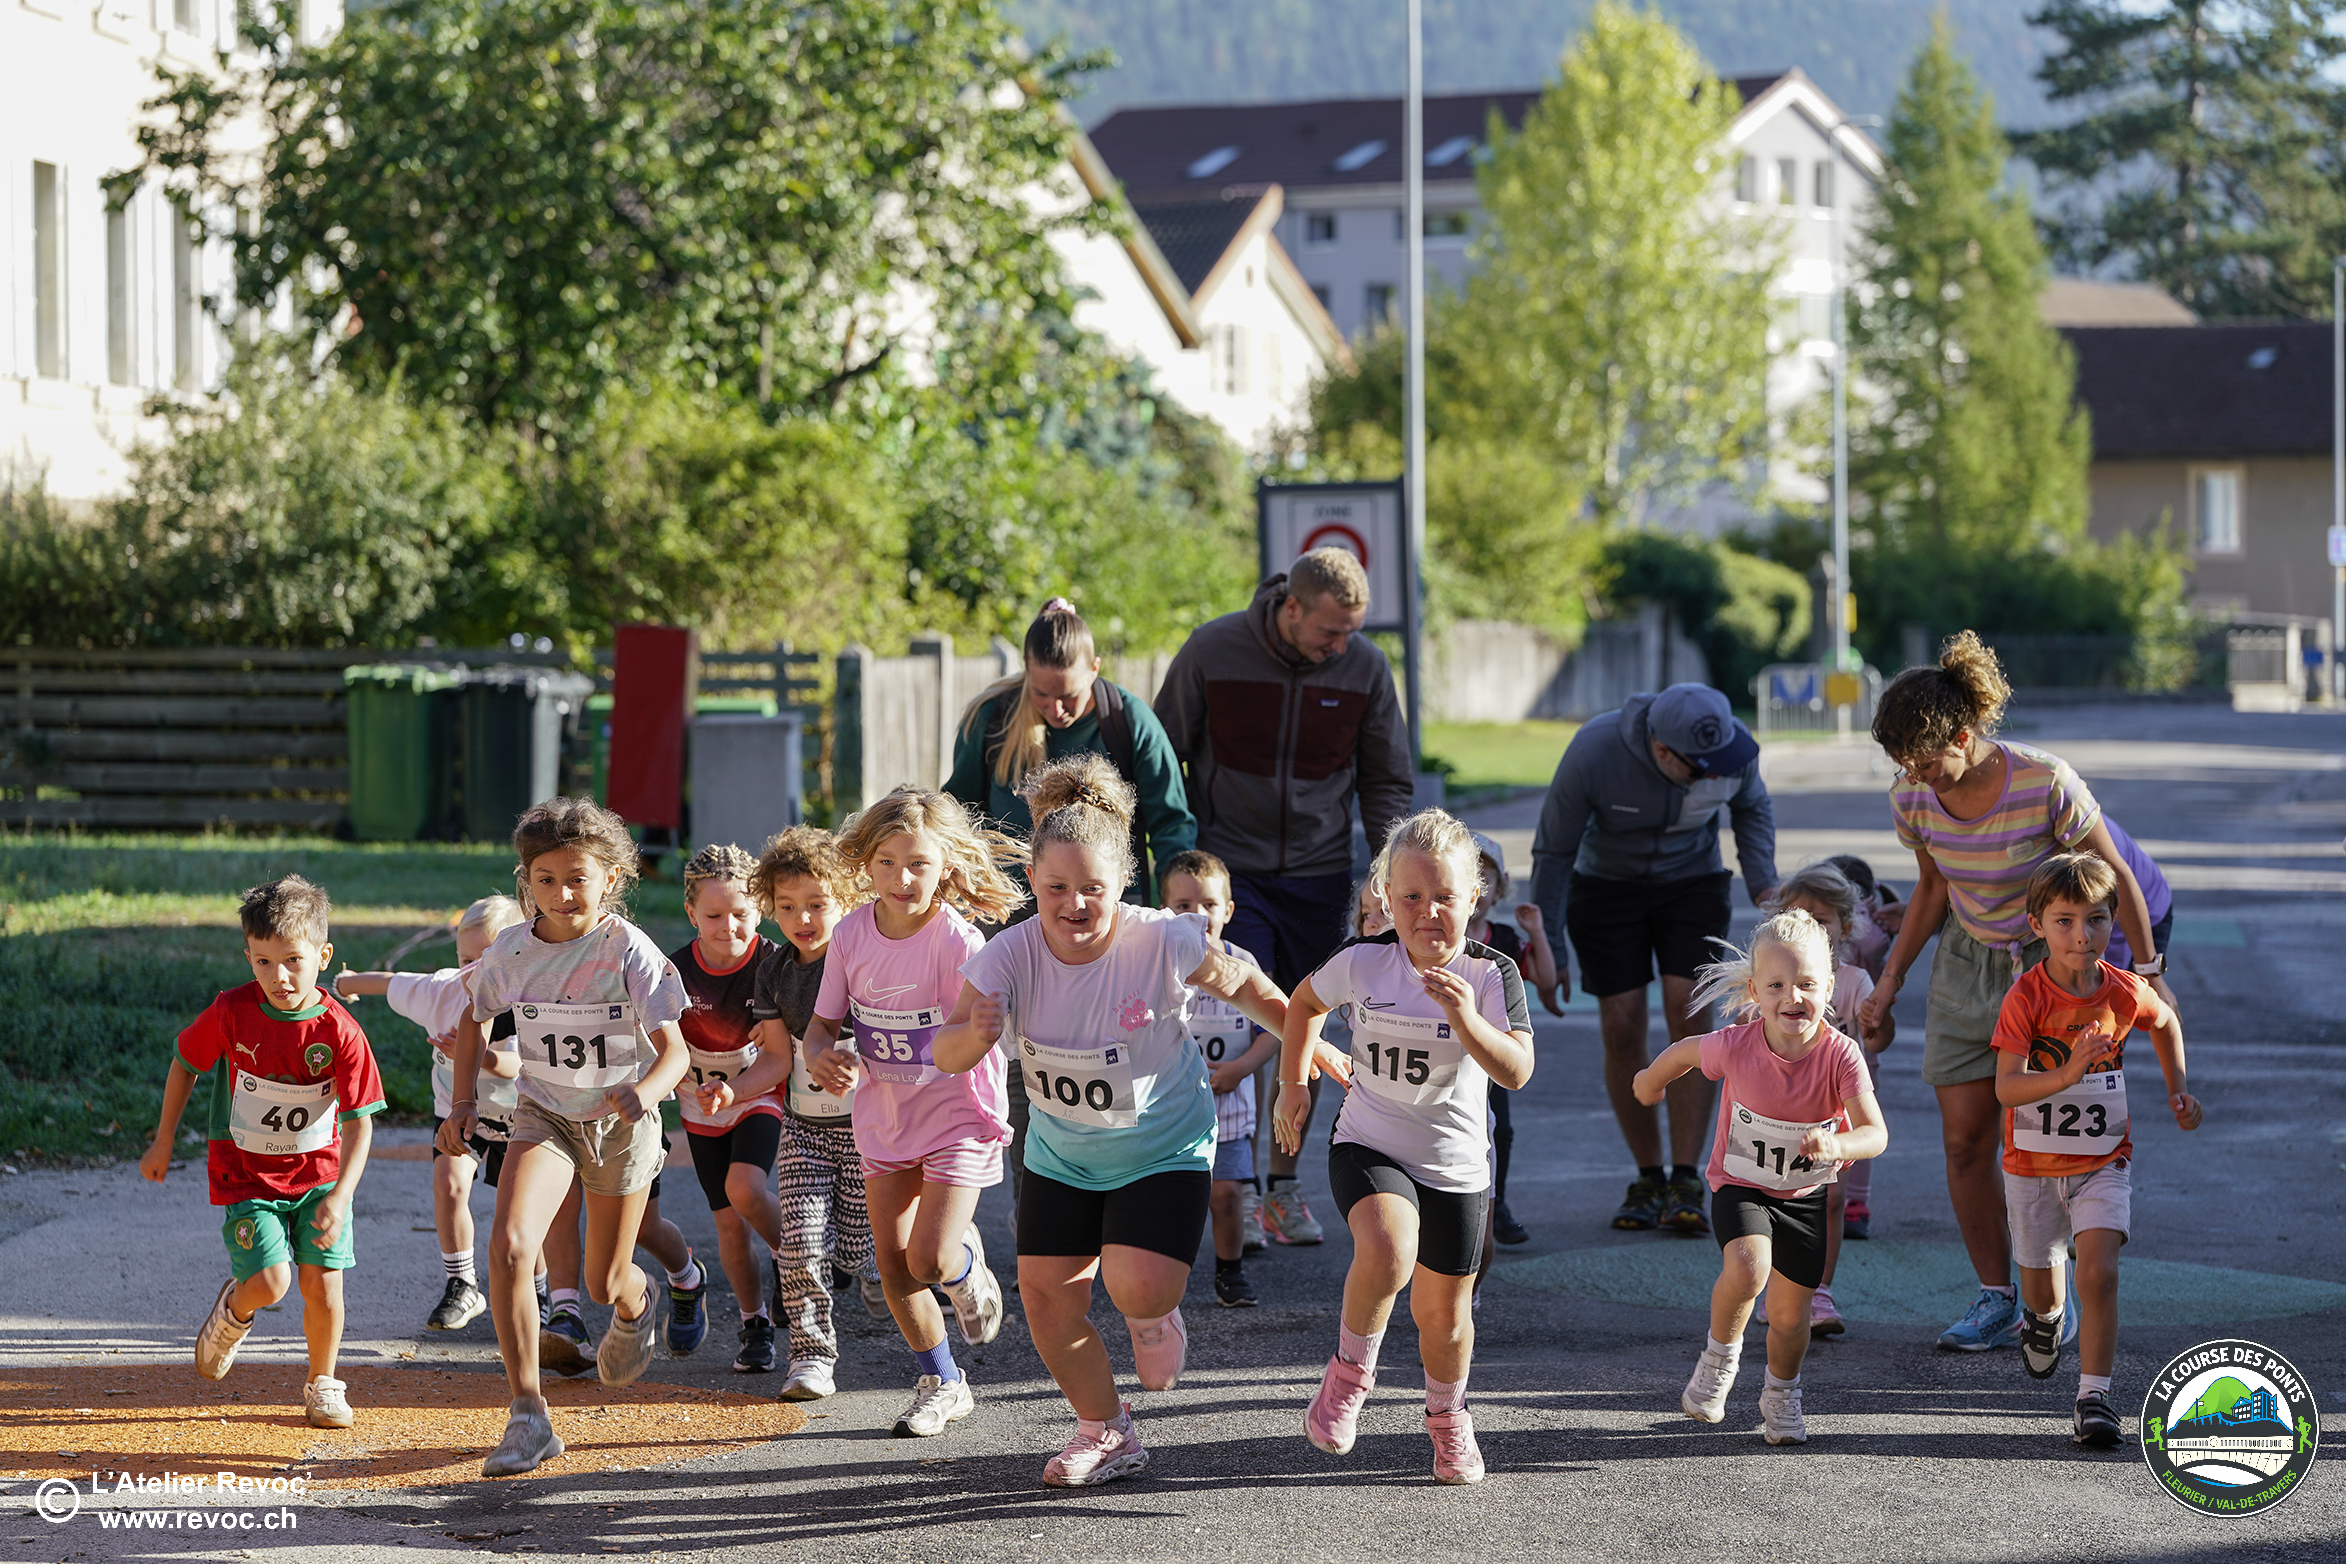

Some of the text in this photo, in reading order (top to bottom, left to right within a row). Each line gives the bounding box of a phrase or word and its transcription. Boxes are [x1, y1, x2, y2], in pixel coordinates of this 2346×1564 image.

[1376, 1016, 1397, 1025] COURSE
[540, 1033, 607, 1070] 131
[871, 1031, 913, 1062] 35
[1045, 1050, 1066, 1058] COURSE
[1367, 1042, 1430, 1085] 115
[876, 1069, 899, 1081] Lena
[267, 1085, 288, 1093] COURSE
[1034, 1070, 1113, 1112] 100
[820, 1103, 840, 1113] Ella
[261, 1105, 309, 1132] 40
[1761, 1120, 1783, 1130] COURSE
[2036, 1102, 2107, 1138] 123
[265, 1142, 298, 1153] Rayan
[1752, 1140, 1813, 1175] 114
